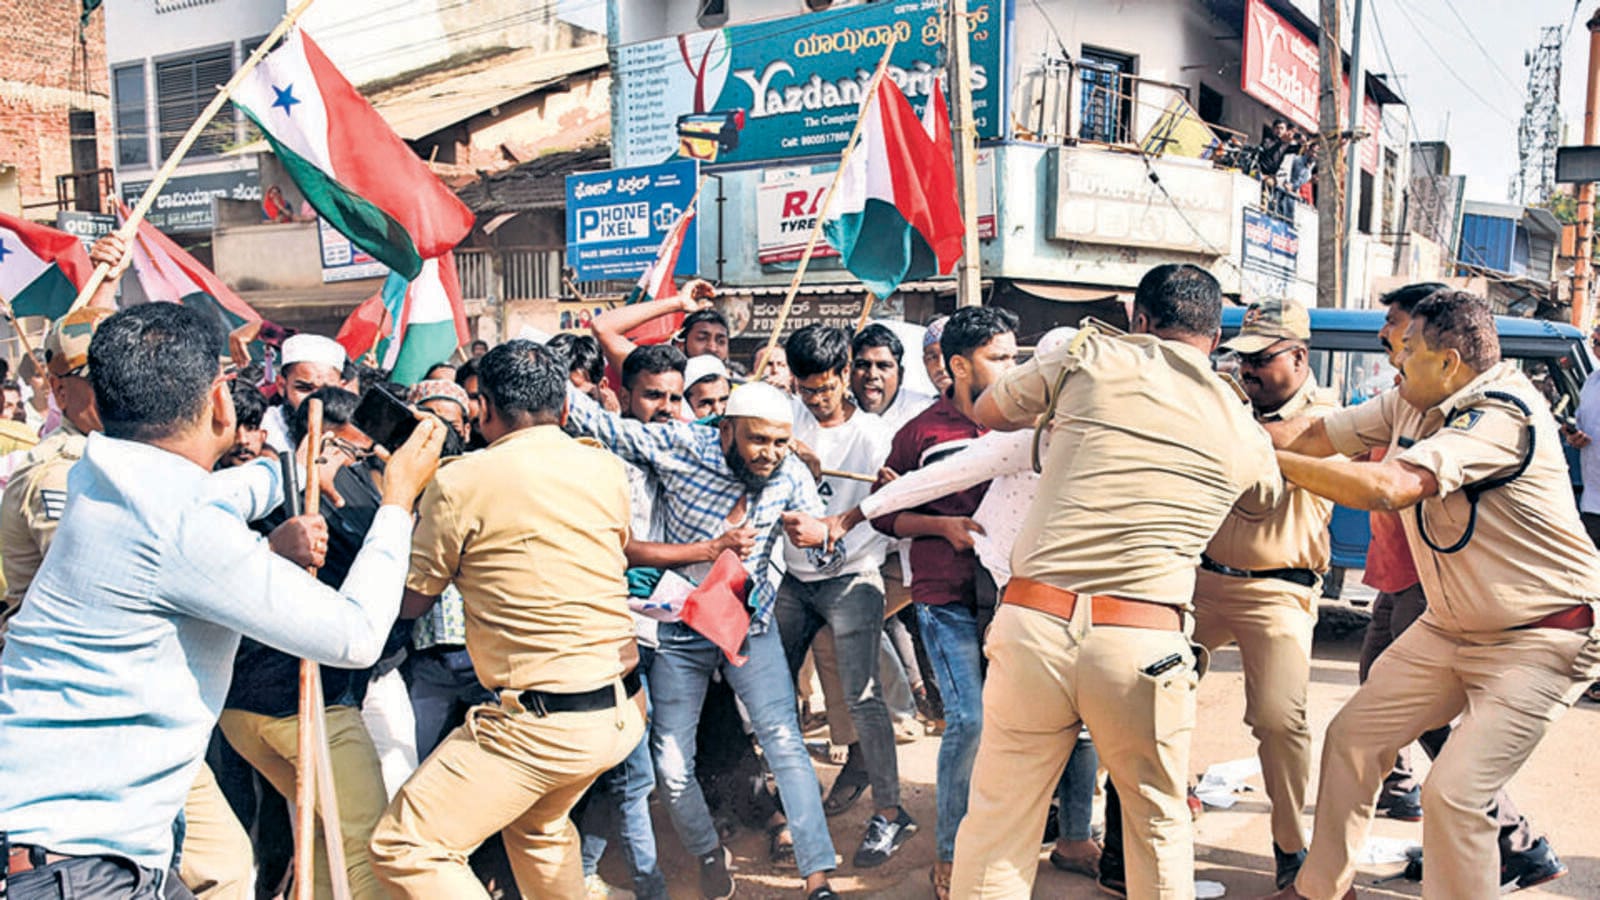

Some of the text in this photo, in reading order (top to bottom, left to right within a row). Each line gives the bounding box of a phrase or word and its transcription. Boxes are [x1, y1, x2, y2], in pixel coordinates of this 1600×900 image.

[734, 61, 987, 119] Yazdani Prins
[804, 116, 820, 128] The
[580, 203, 648, 240] PHONE
